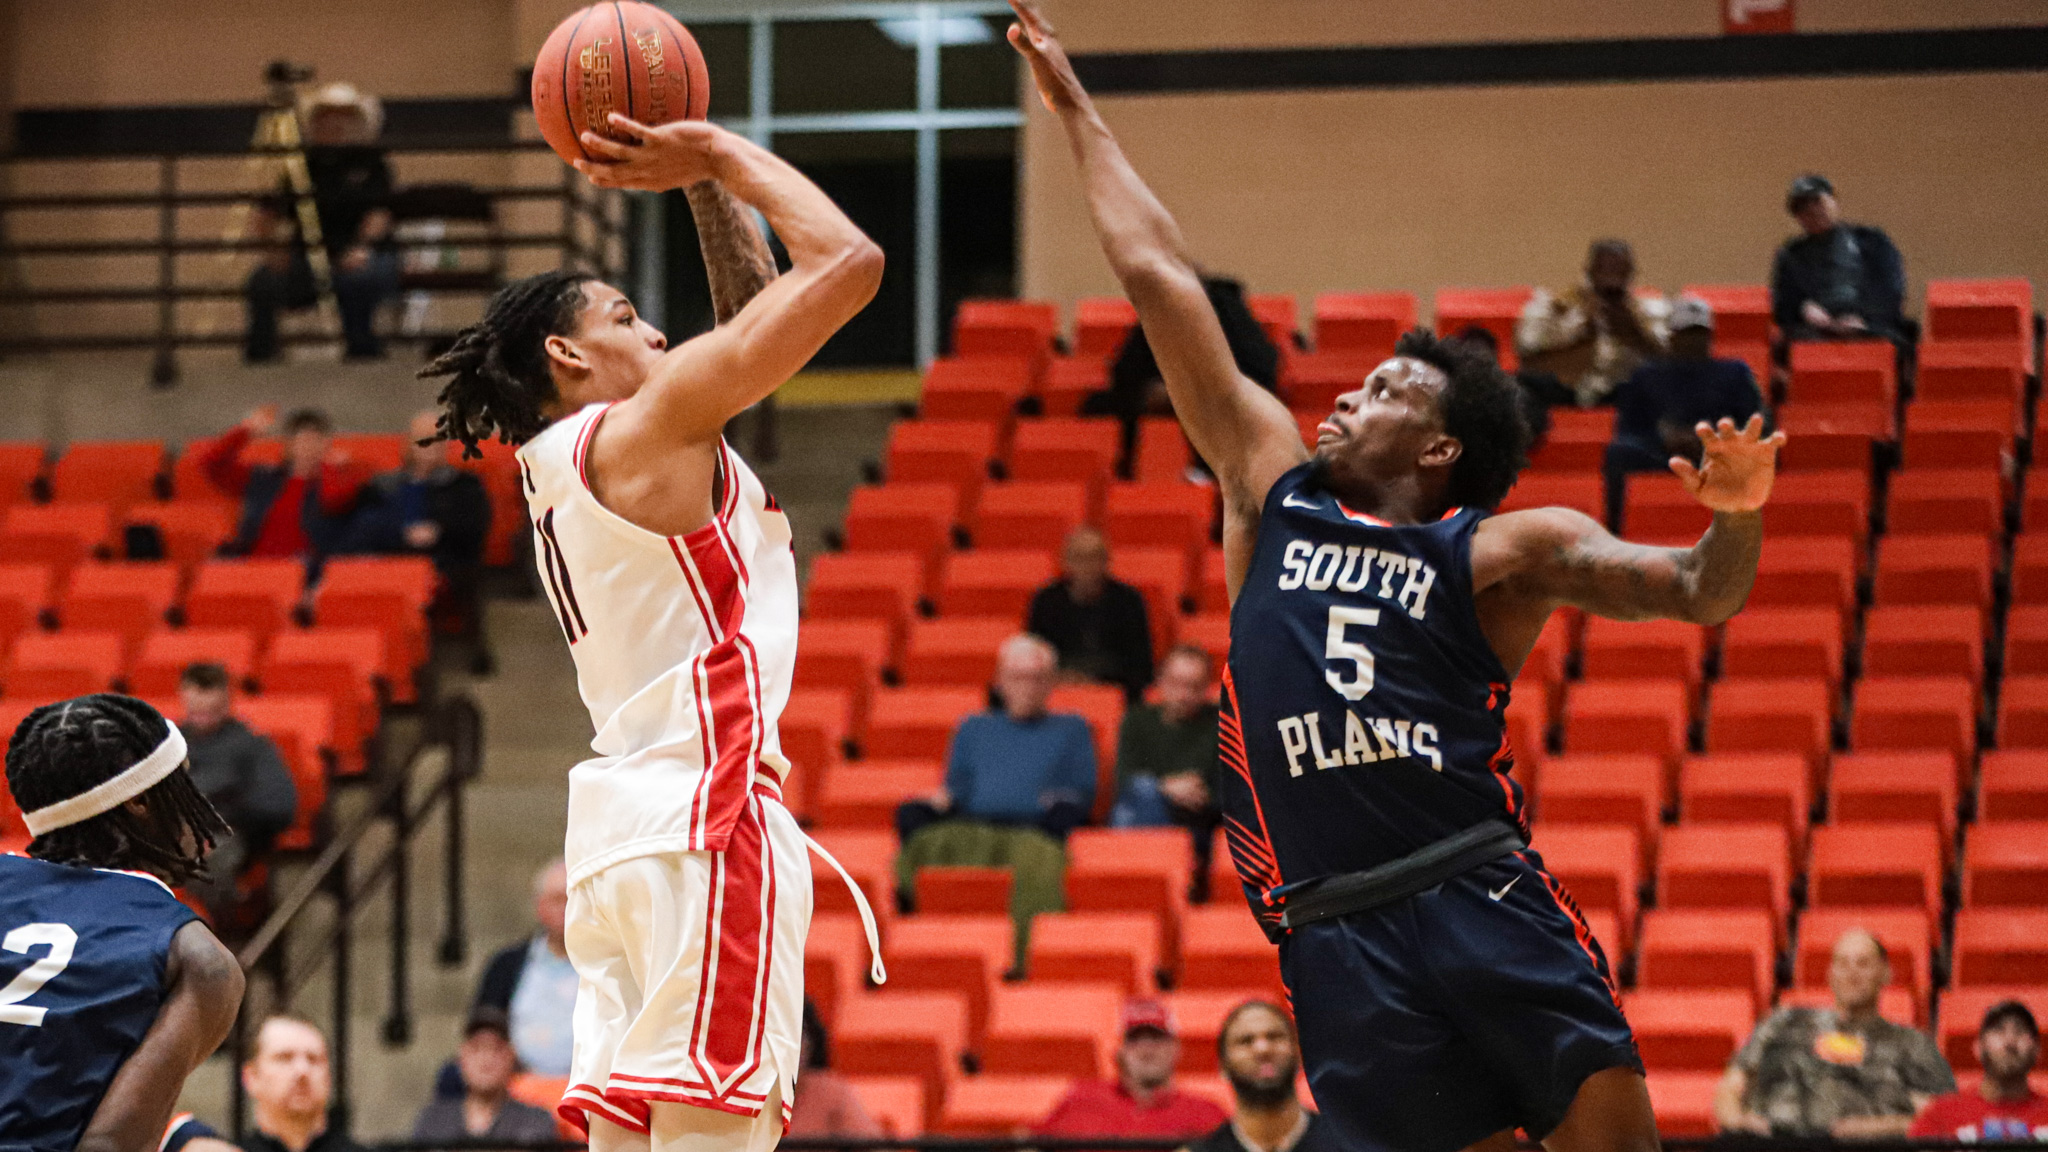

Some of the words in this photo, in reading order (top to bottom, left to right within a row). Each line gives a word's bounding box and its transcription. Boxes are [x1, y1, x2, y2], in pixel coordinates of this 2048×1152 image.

[1278, 539, 1437, 620] SOUTH
[1325, 605, 1381, 701] 5
[0, 922, 79, 1027] 2
